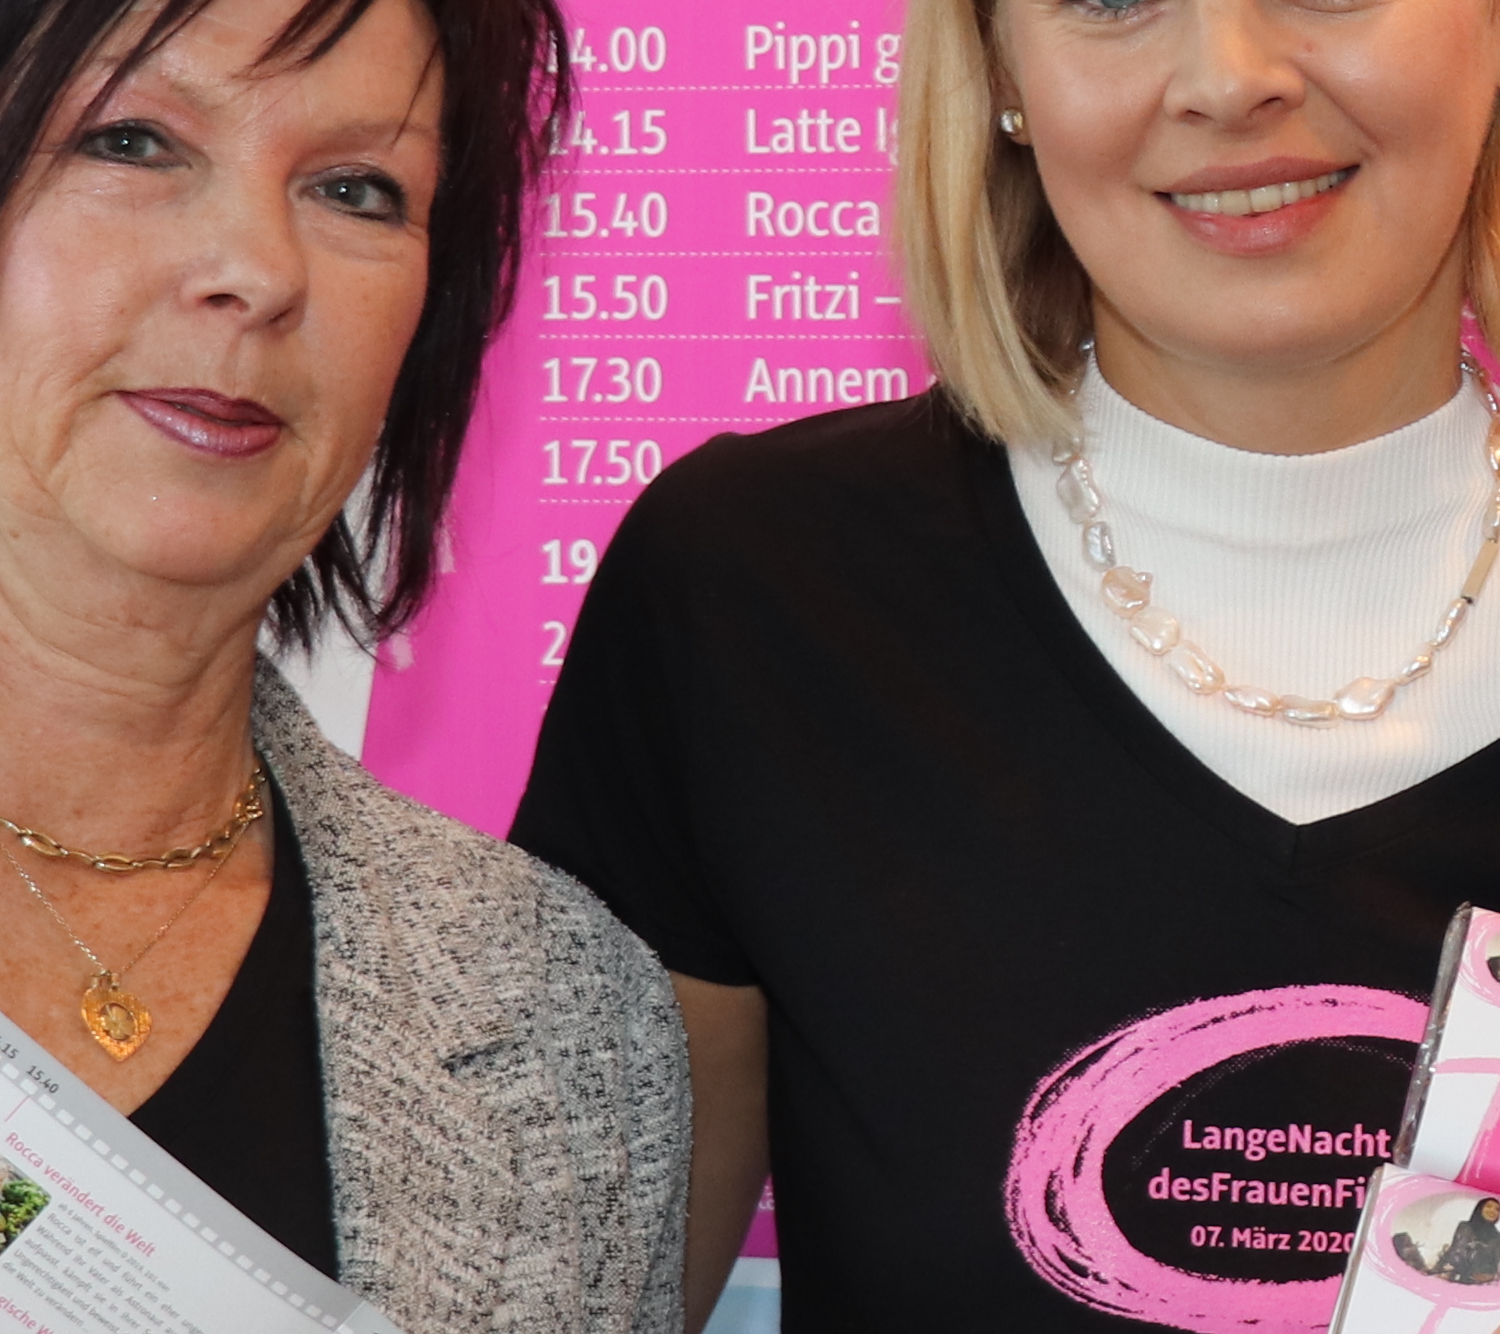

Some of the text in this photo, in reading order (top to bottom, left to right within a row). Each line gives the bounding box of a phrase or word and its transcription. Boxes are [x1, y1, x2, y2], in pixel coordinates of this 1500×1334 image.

[746, 20, 860, 84] Pippi
[747, 107, 861, 155] Latte
[543, 191, 881, 238] 15.40 Rocca
[542, 271, 860, 321] 15.50 Fritzi
[542, 356, 663, 403] 17.30
[542, 439, 663, 485] 17.50
[26, 1065, 58, 1093] 15.40
[1182, 1119, 1392, 1160] LangeNacht
[5, 1130, 154, 1256] Rocca verändert die Welt
[1190, 1225, 1224, 1247] 07.
[1231, 1226, 1291, 1251] März
